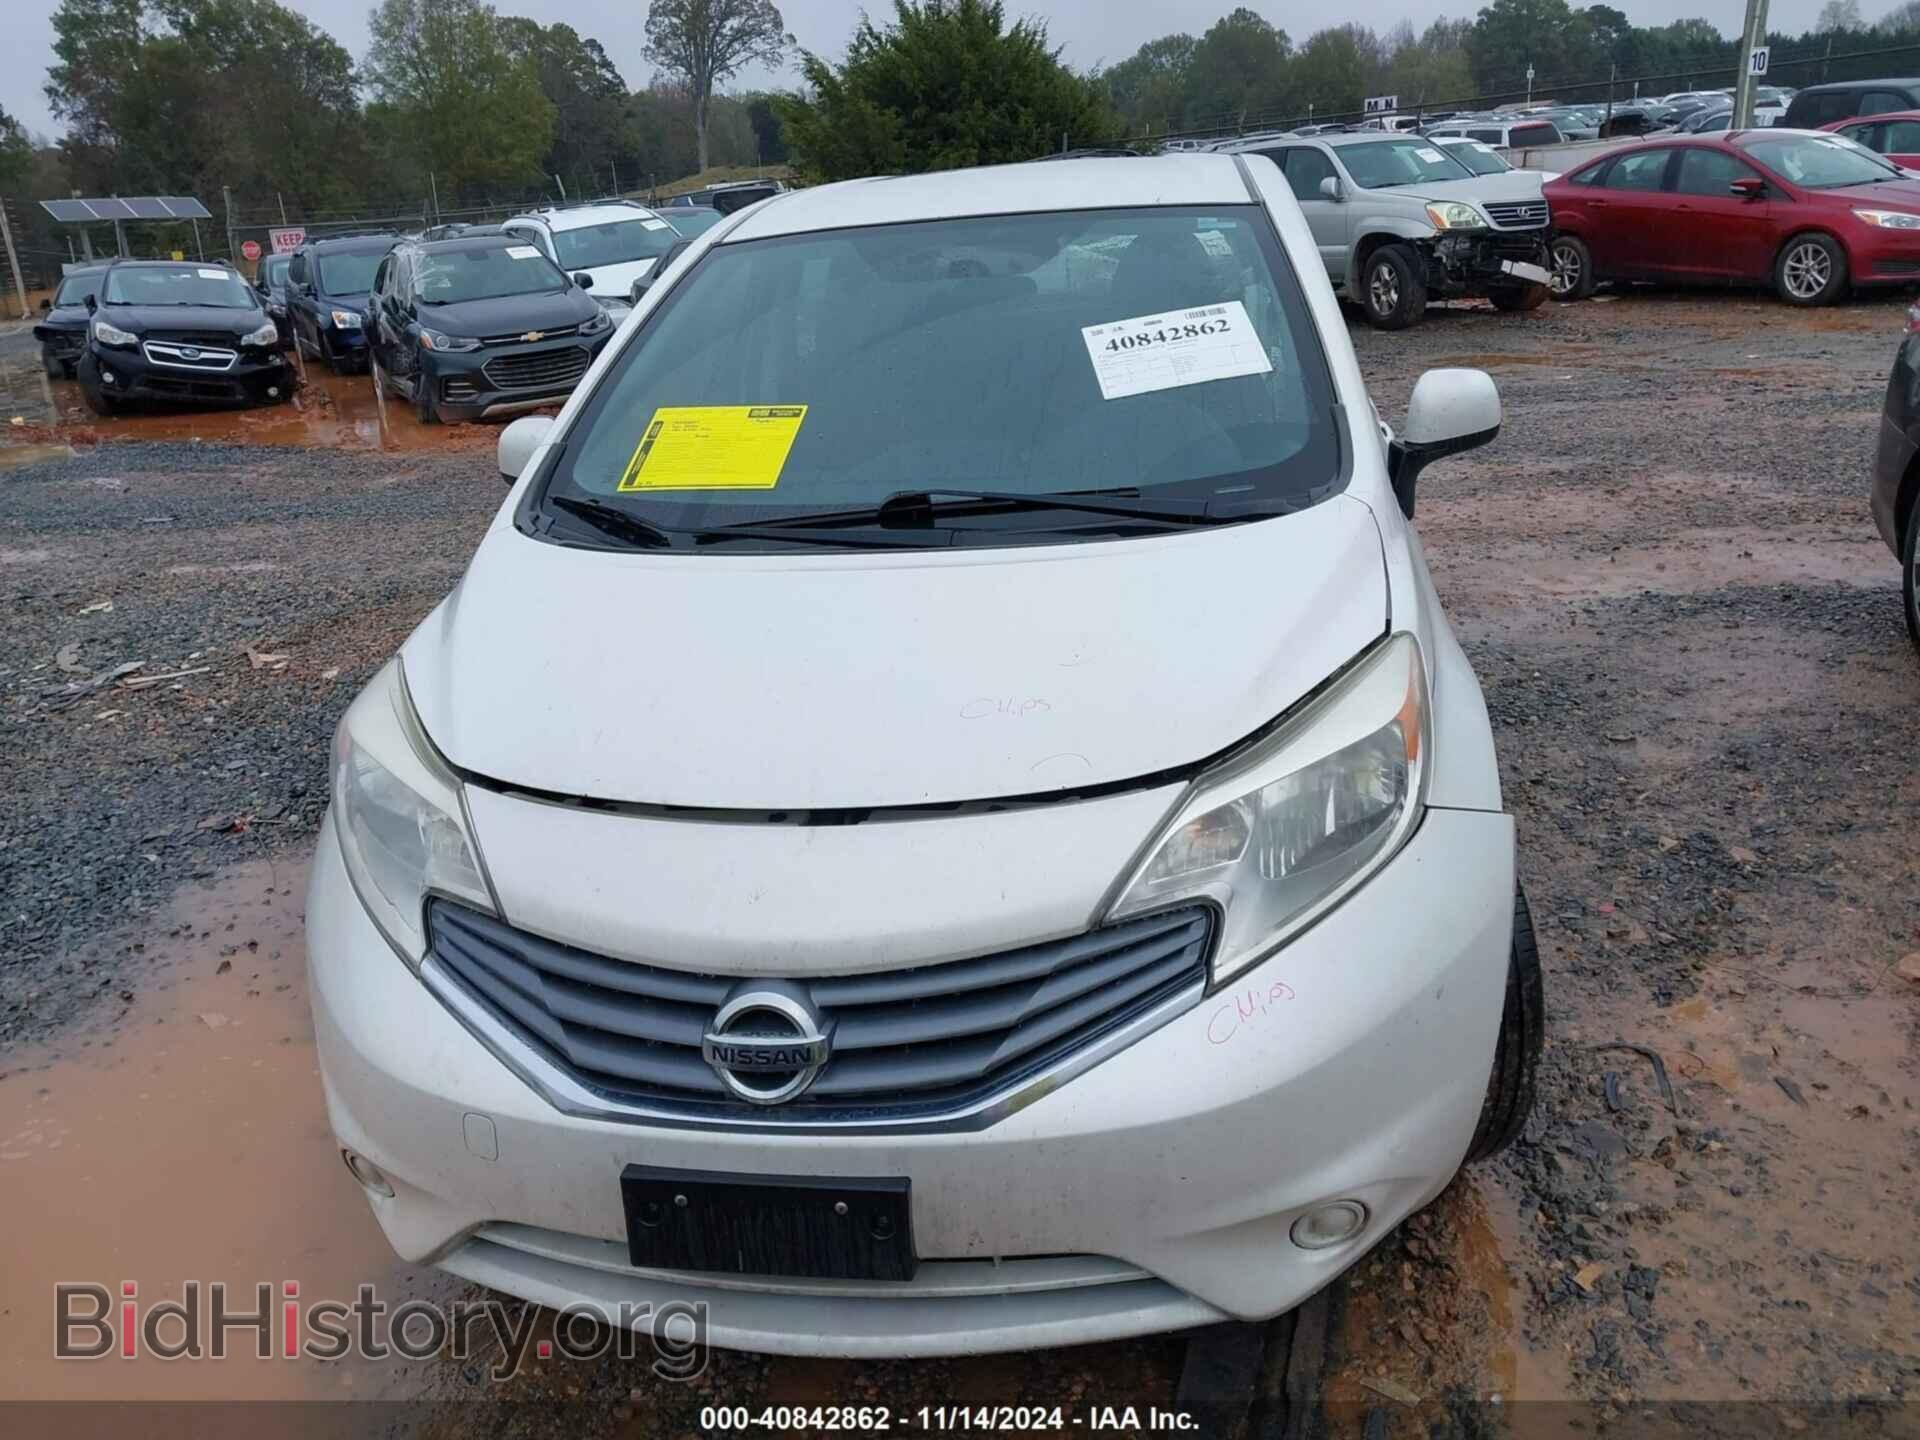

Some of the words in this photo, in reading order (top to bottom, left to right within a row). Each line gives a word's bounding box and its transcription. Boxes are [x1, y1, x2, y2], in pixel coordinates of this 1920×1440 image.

[1752, 51, 1766, 71] 10
[275, 233, 302, 246] KEEP
[1105, 318, 1231, 352] 40842862
[711, 1046, 812, 1065] NISSAN
